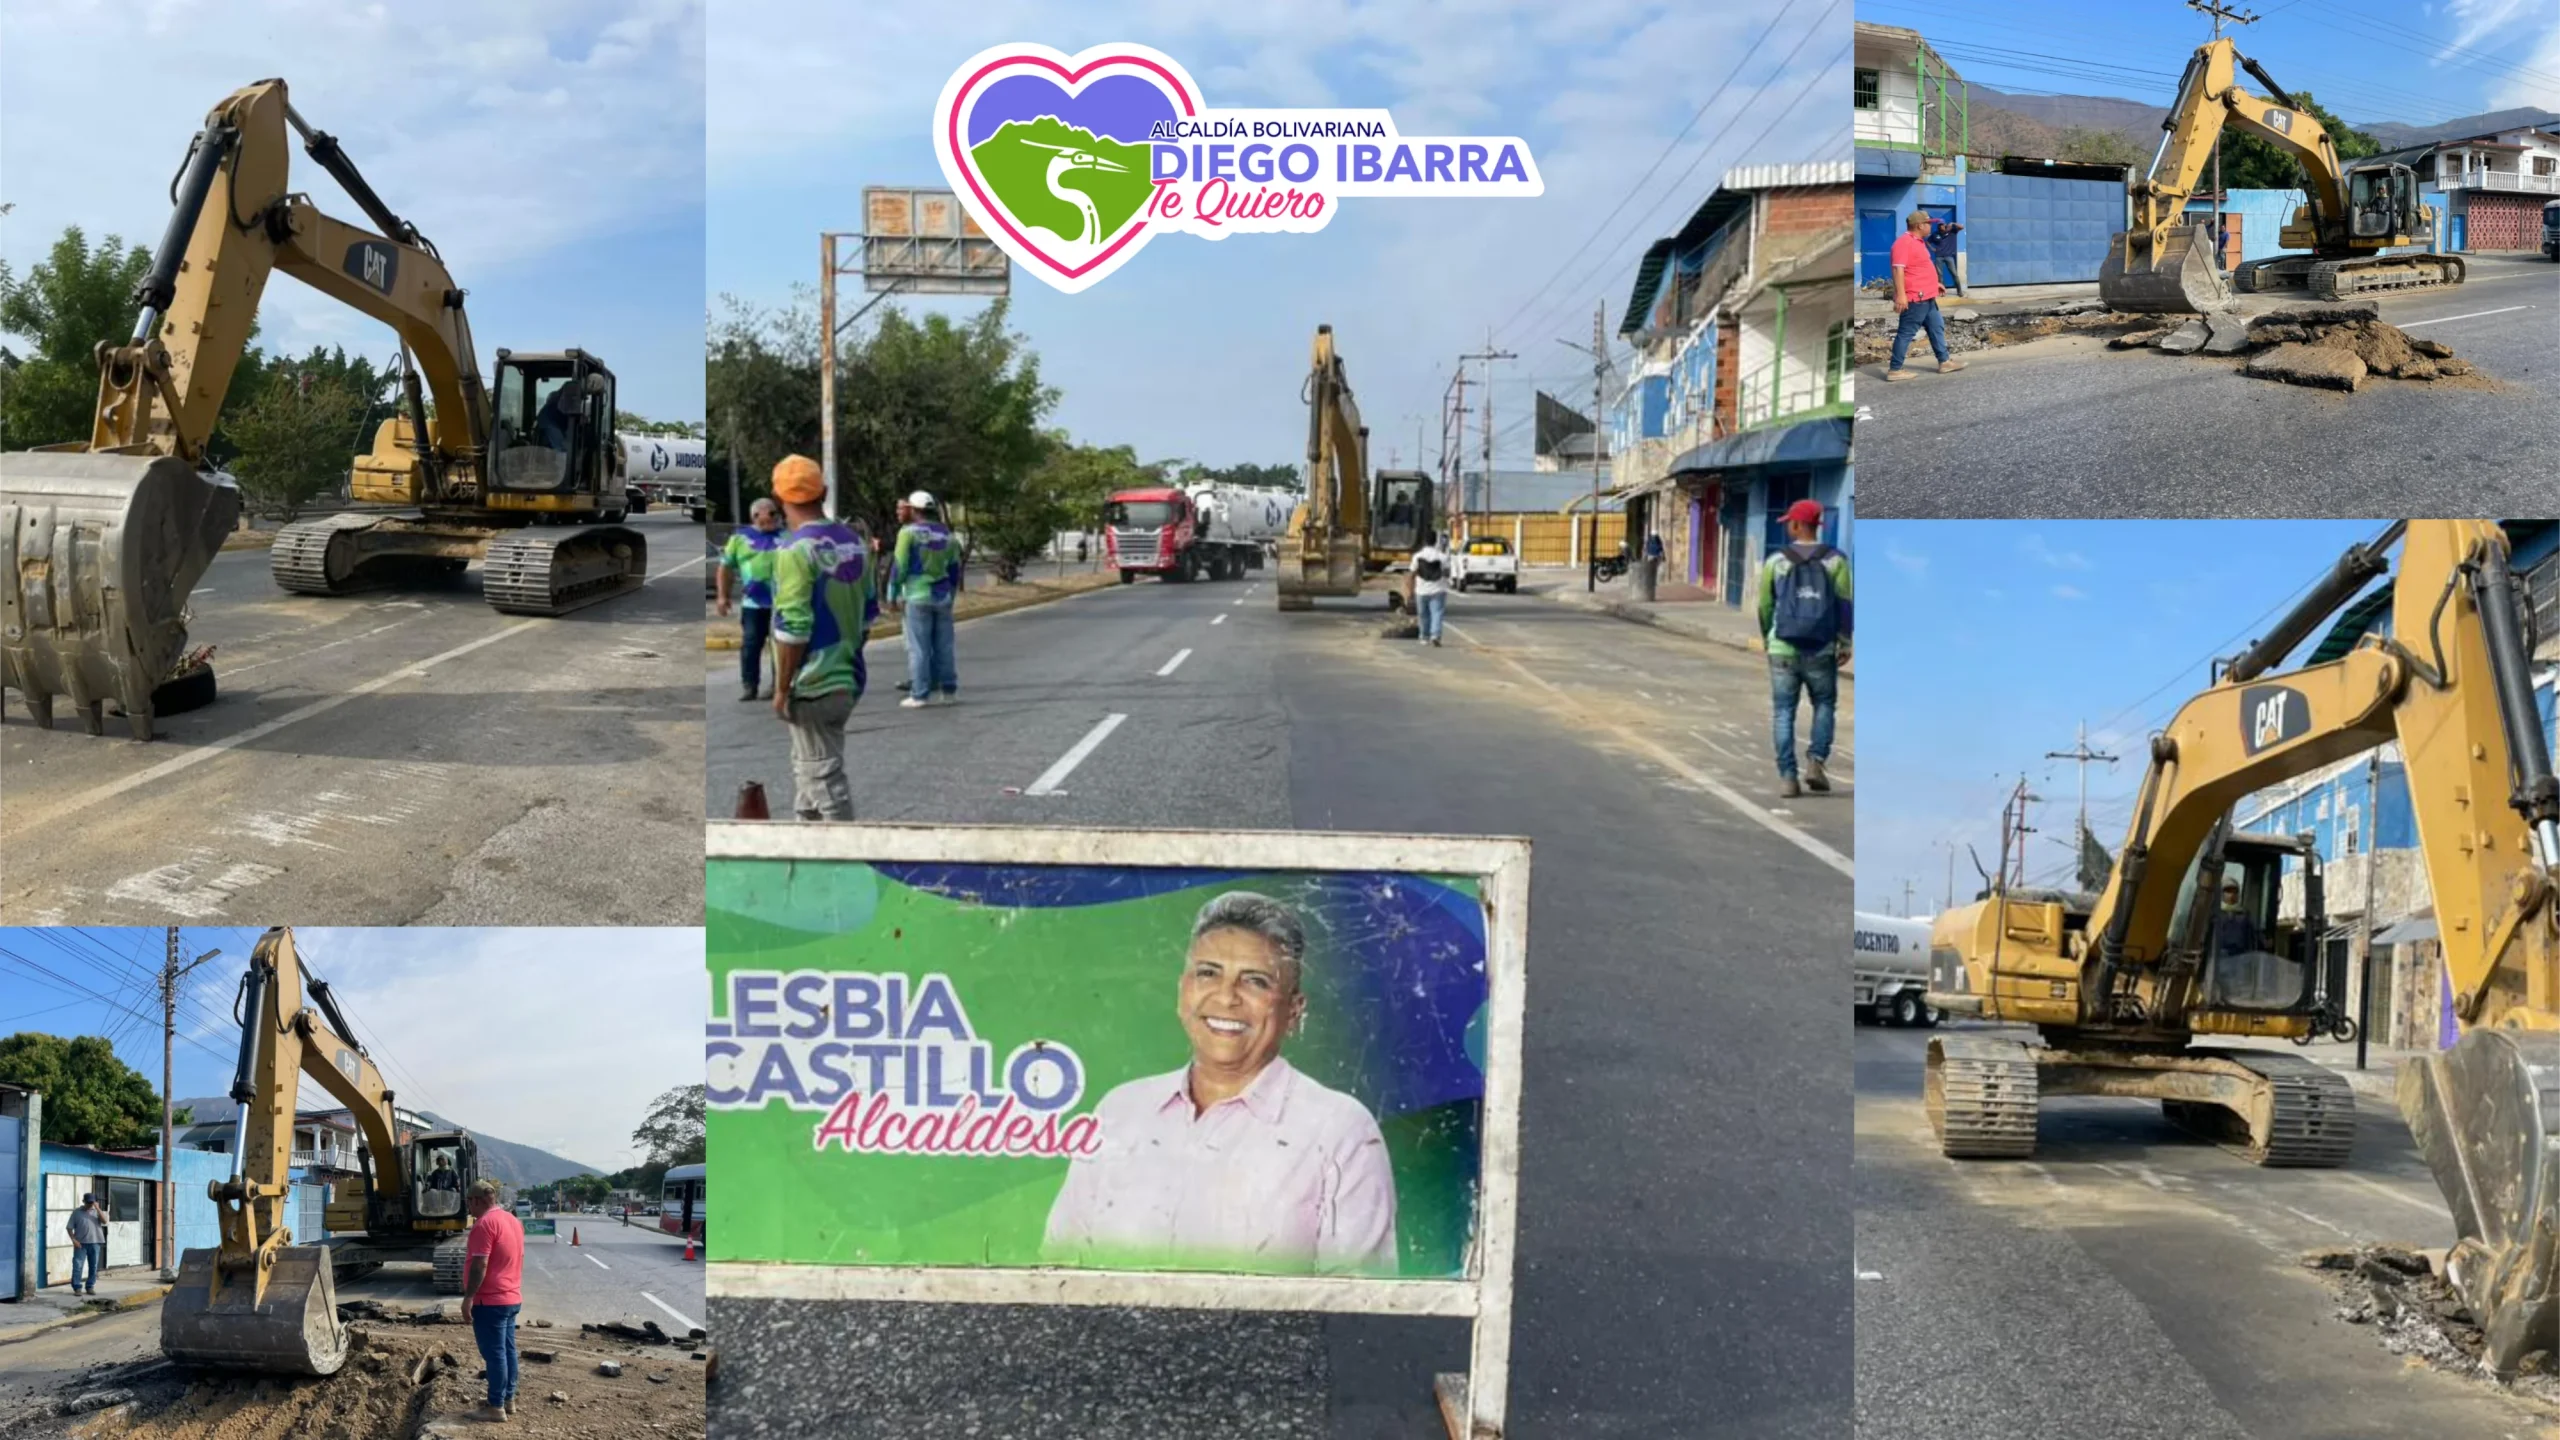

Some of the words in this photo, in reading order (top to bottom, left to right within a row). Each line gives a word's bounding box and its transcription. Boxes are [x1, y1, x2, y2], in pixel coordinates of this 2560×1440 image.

[2273, 110, 2287, 133] CAT
[364, 244, 387, 290] CAT
[2255, 689, 2288, 749] CAT
[344, 1051, 356, 1082] CAT
[706, 1040, 1079, 1111] CASTILLO
[816, 1091, 1103, 1155] Alcaldesa
